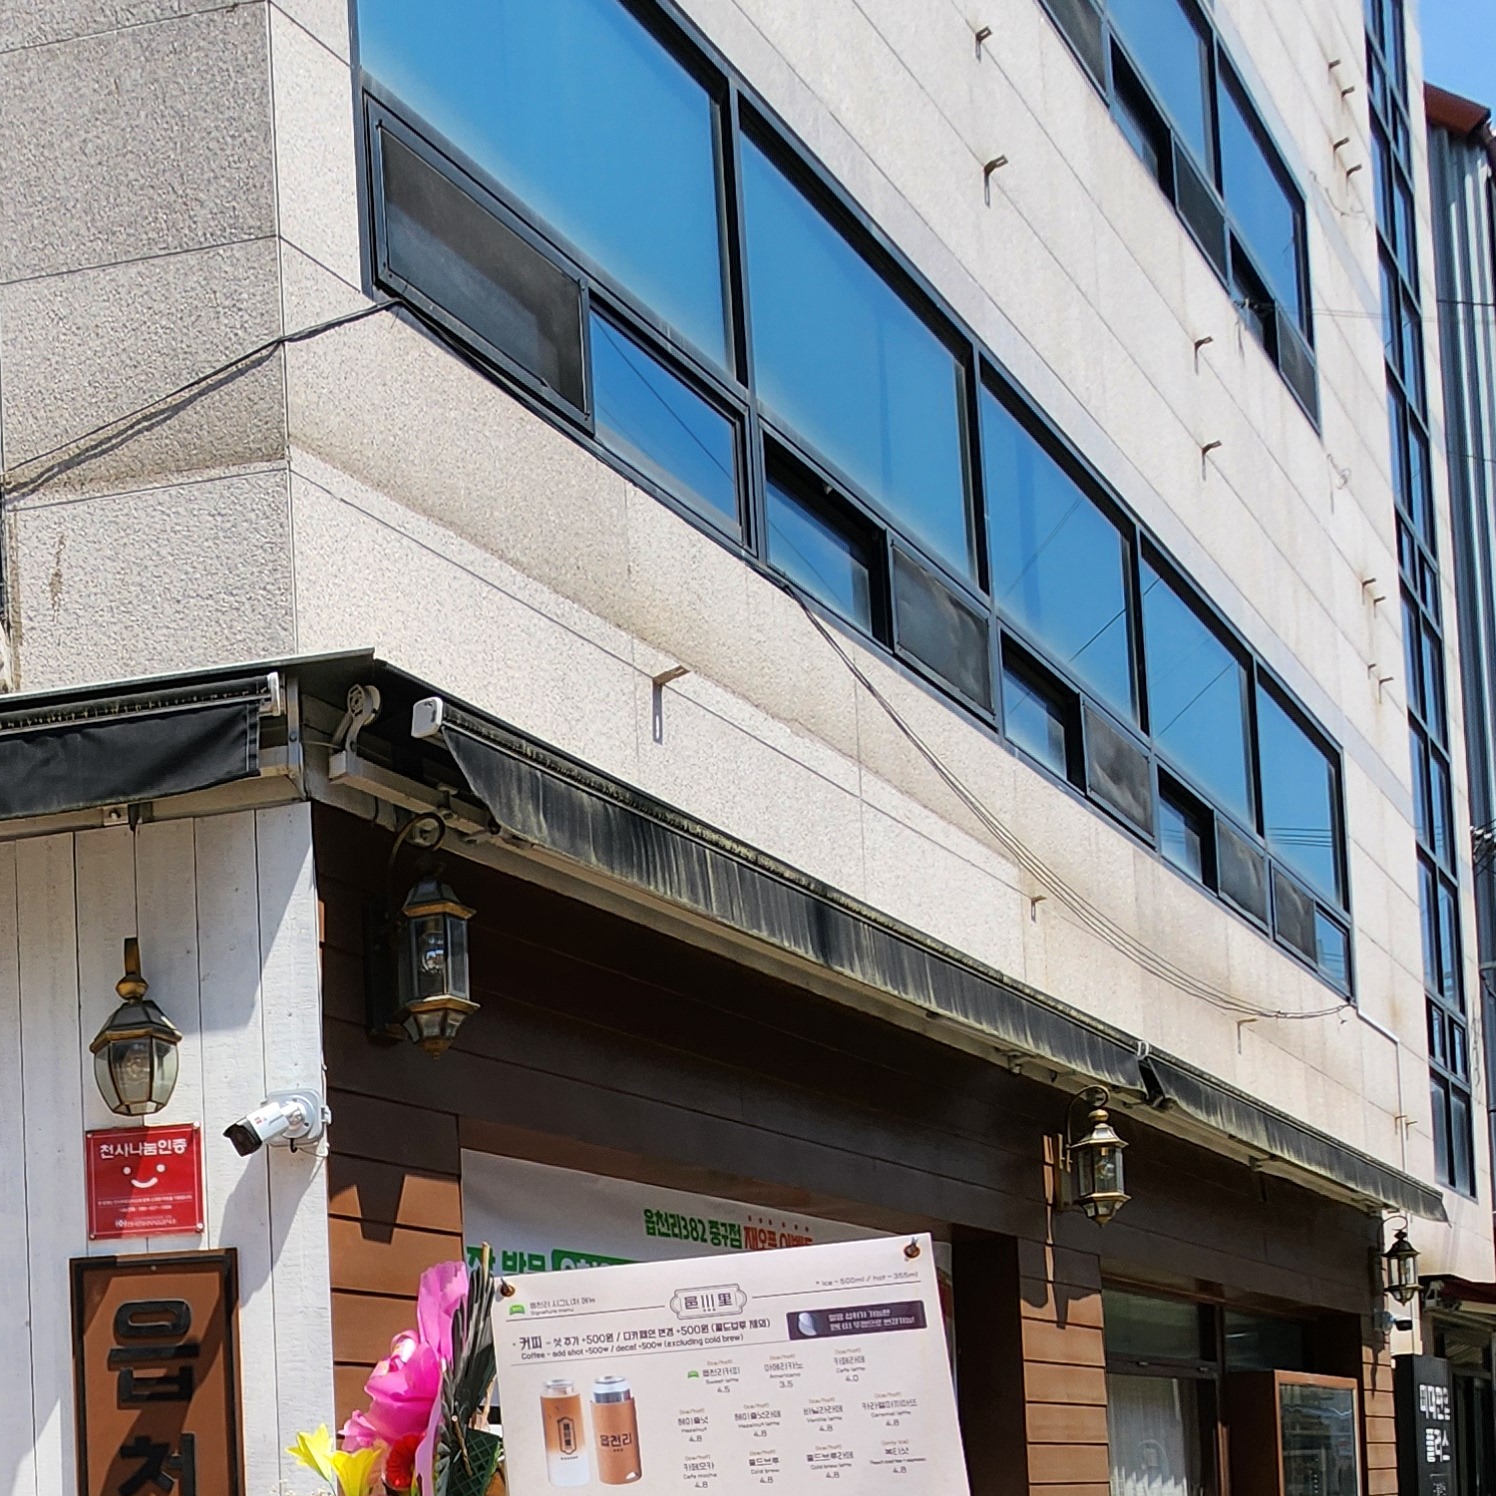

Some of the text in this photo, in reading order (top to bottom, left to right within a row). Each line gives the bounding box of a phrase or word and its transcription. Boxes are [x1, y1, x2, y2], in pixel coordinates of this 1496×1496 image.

[644, 1208, 708, 1242] 읍천리382
[519, 1336, 542, 1350] 커피
[521, 1351, 544, 1360] Coffee
[664, 1336, 703, 1350] (excluding
[705, 1336, 721, 1344] cold
[723, 1334, 744, 1343] brew)
